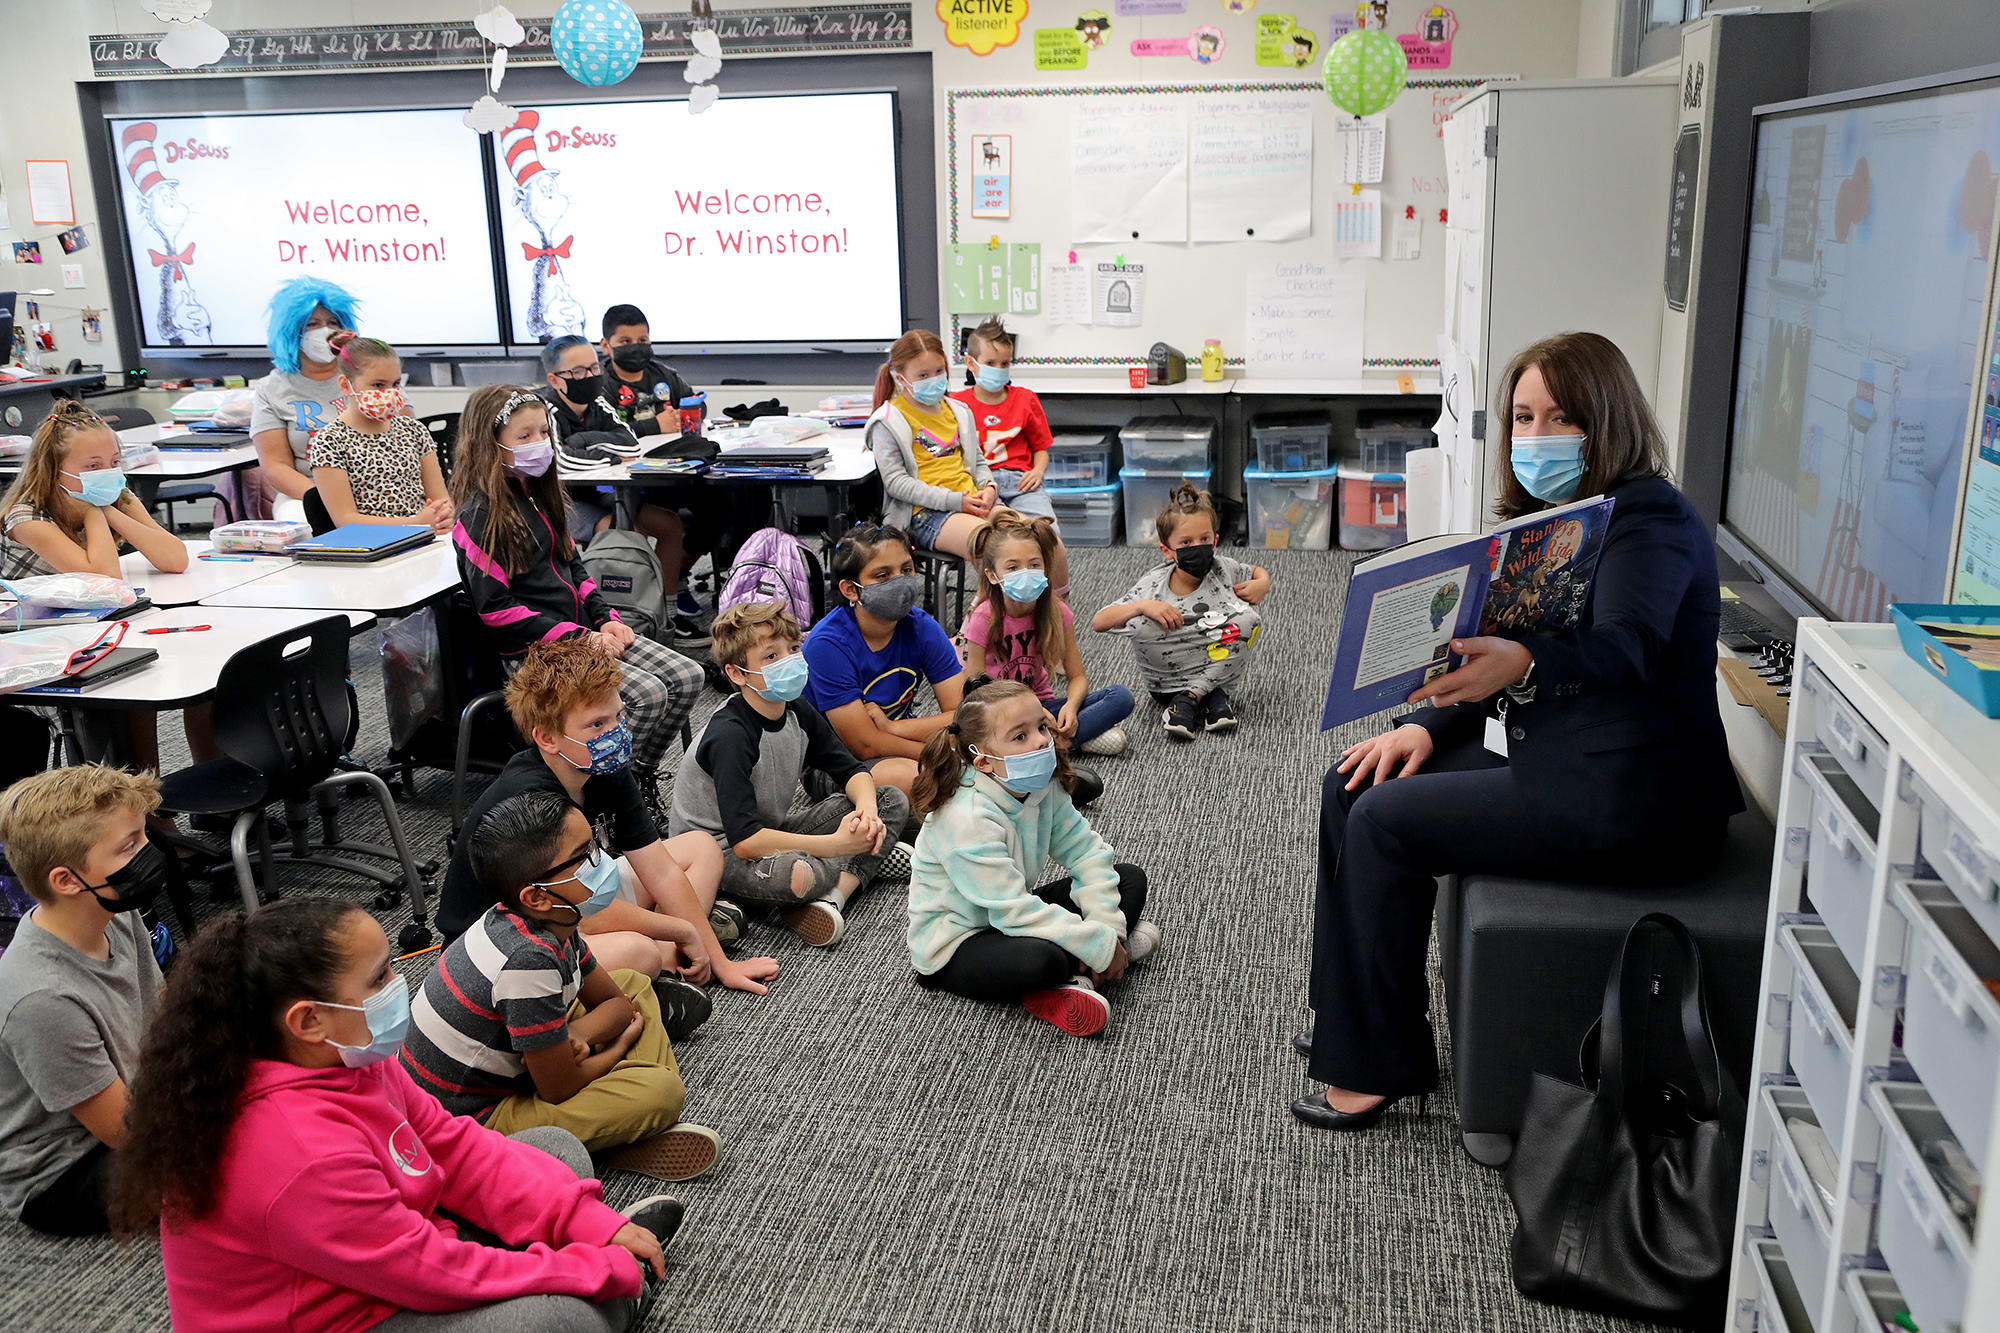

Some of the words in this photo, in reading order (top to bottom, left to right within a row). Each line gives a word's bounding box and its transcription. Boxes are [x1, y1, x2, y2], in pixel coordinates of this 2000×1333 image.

[951, 0, 1013, 14] ACTIVE
[955, 16, 1008, 30] listener!
[439, 30, 481, 49] Mm
[94, 43, 118, 61] Aa
[122, 41, 144, 60] Bb
[1039, 57, 1078, 66] SPEAKING
[983, 176, 999, 186] air
[674, 189, 831, 217] Welcome,
[284, 200, 429, 227] Welcome,
[278, 240, 316, 264] Dr.
[325, 237, 447, 263] Winston!
[664, 231, 704, 256] Dr.
[716, 227, 848, 255] Winston!
[1275, 261, 1303, 278] Good
[1305, 261, 1327, 276] Plan
[1286, 278, 1335, 292] Checklist
[1260, 304, 1295, 320] Makes
[1257, 327, 1298, 343] Simple
[1520, 517, 1577, 551] Stanley's
[1507, 545, 1541, 577] Wild
[1543, 538, 1574, 561] Ride
